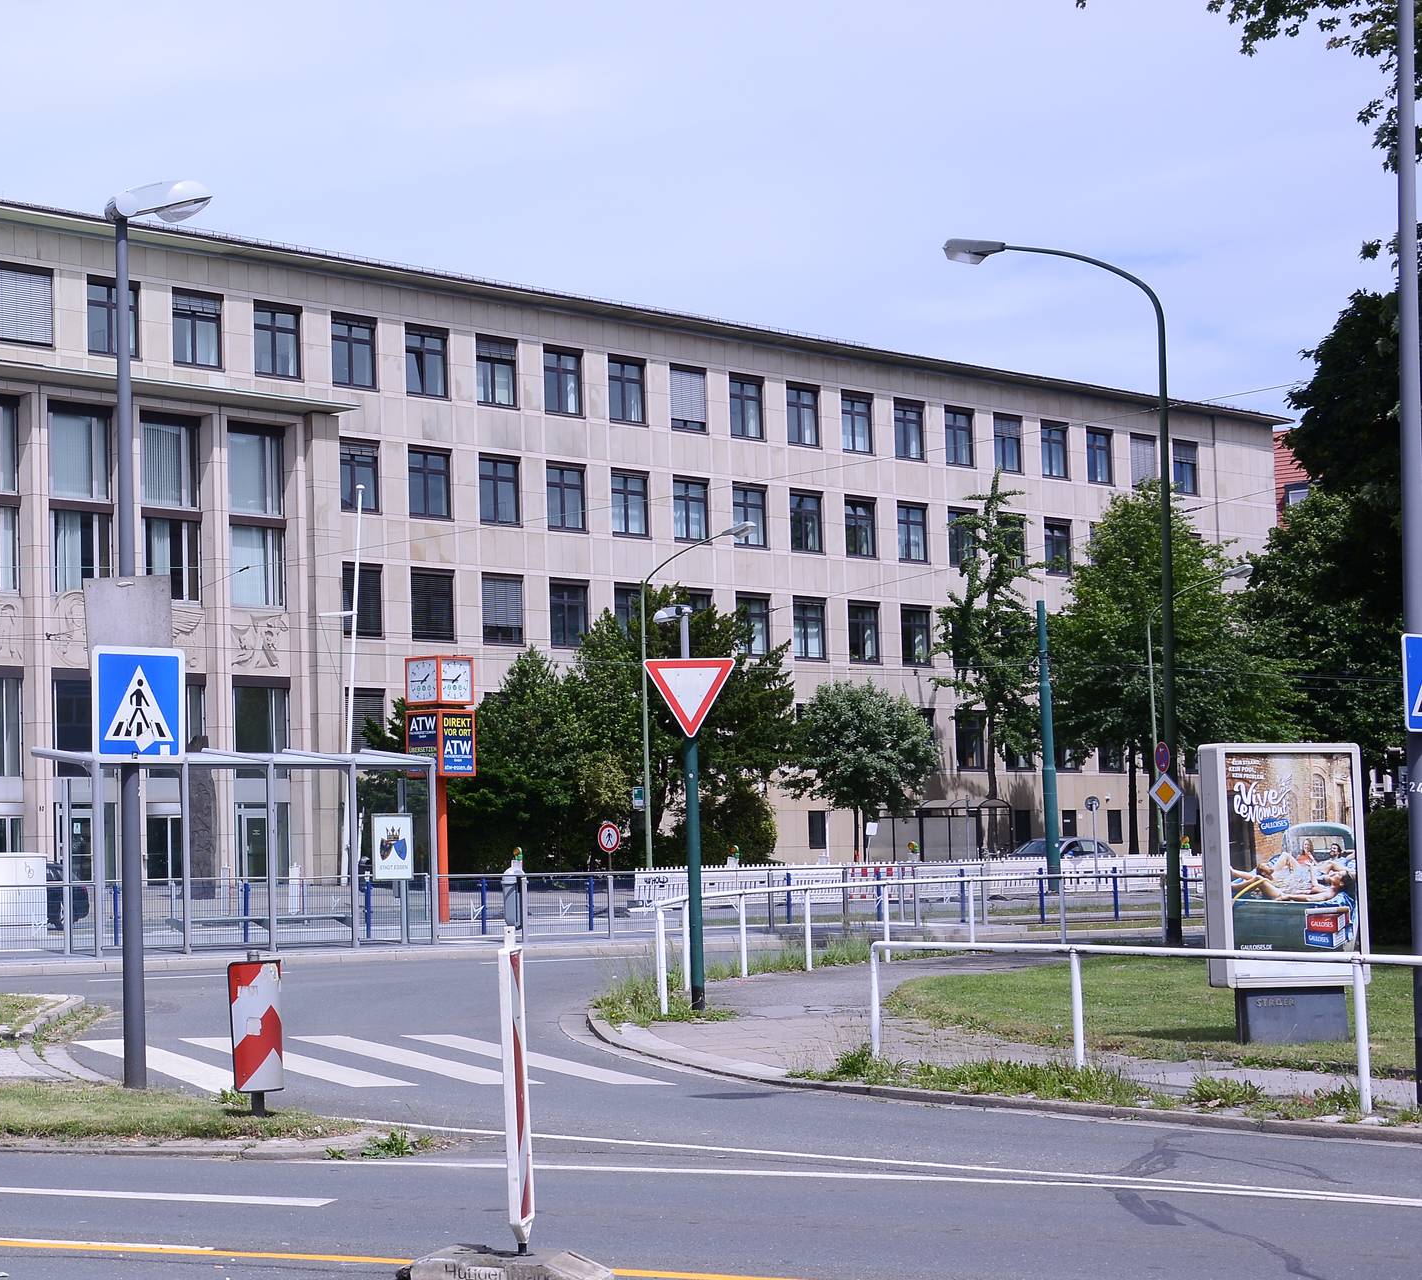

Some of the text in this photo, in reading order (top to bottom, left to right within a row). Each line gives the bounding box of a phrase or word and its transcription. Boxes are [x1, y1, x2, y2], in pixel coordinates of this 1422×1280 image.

[410, 716, 436, 732] ATW
[444, 718, 471, 727] DIREKT
[444, 728, 471, 737] VOR ORT
[444, 740, 472, 755] ATW
[1233, 782, 1291, 806] Vive
[1246, 800, 1287, 824] Moment
